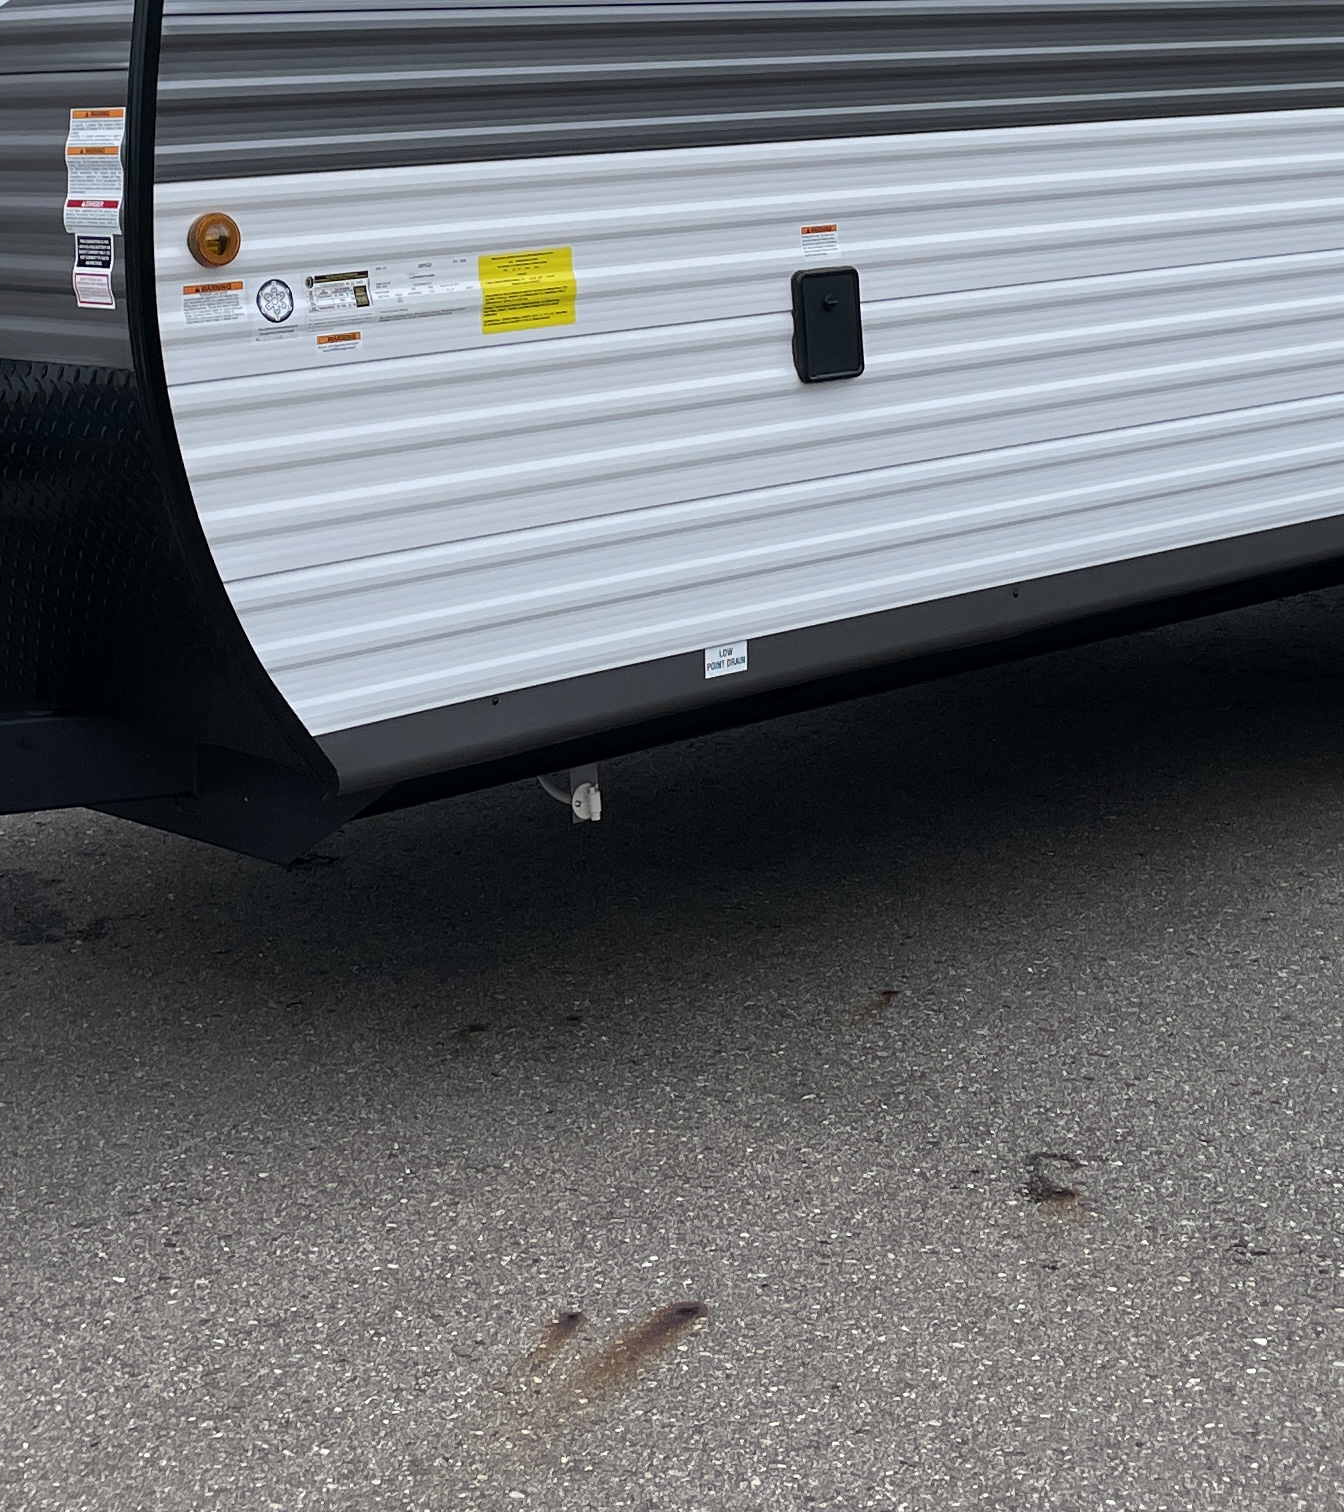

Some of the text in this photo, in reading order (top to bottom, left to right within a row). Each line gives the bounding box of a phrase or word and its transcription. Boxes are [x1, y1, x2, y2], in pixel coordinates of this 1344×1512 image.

[719, 647, 733, 658] LOW
[707, 656, 746, 672] POINT DRAIN
